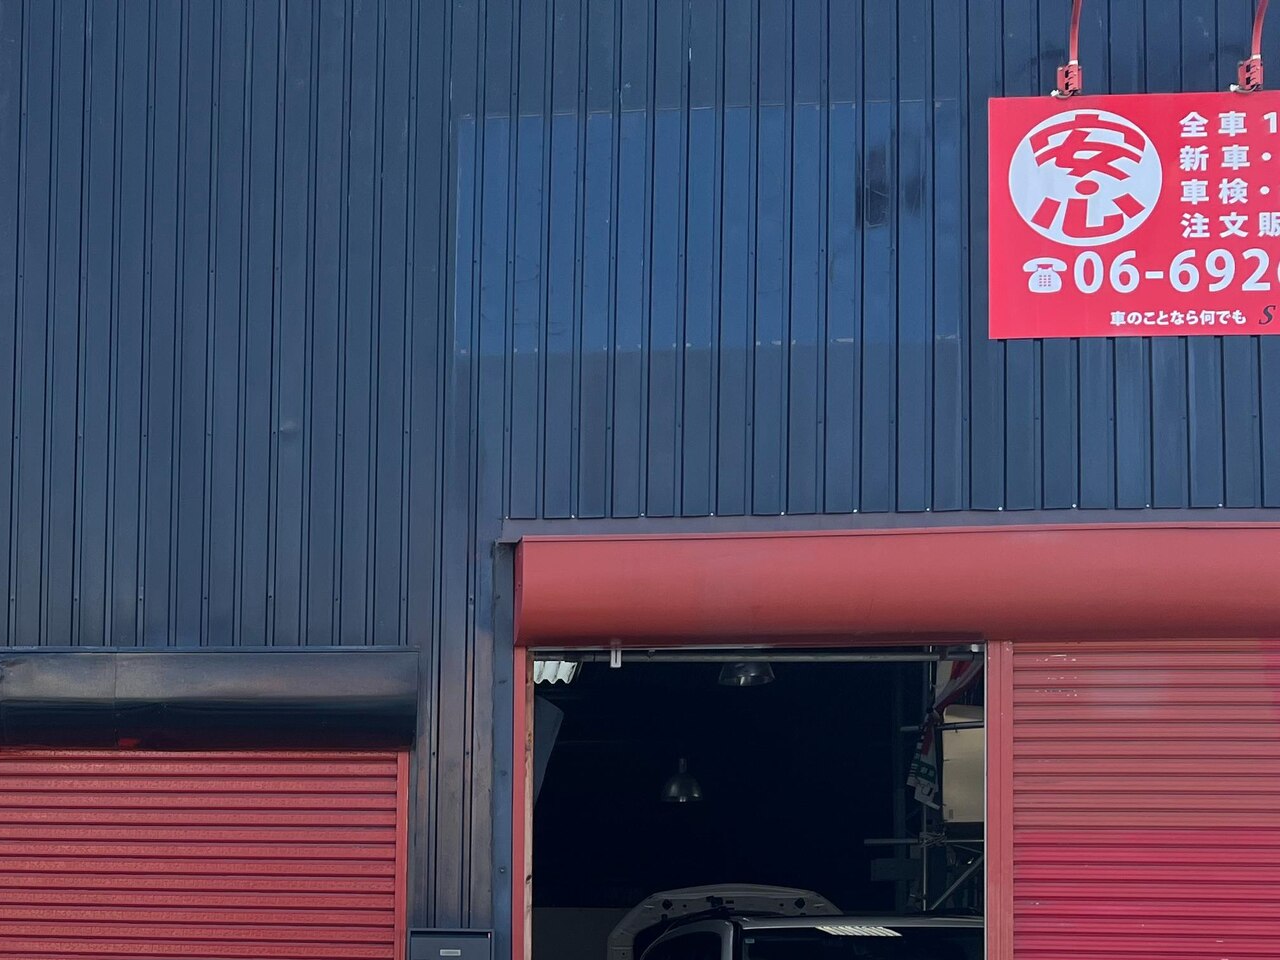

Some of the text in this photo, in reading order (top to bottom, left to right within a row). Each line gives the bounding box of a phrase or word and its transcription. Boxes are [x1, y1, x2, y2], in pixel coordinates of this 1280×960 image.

[1073, 247, 1280, 295] 06-692
[1109, 309, 1247, 327] 車のことなら何でも
